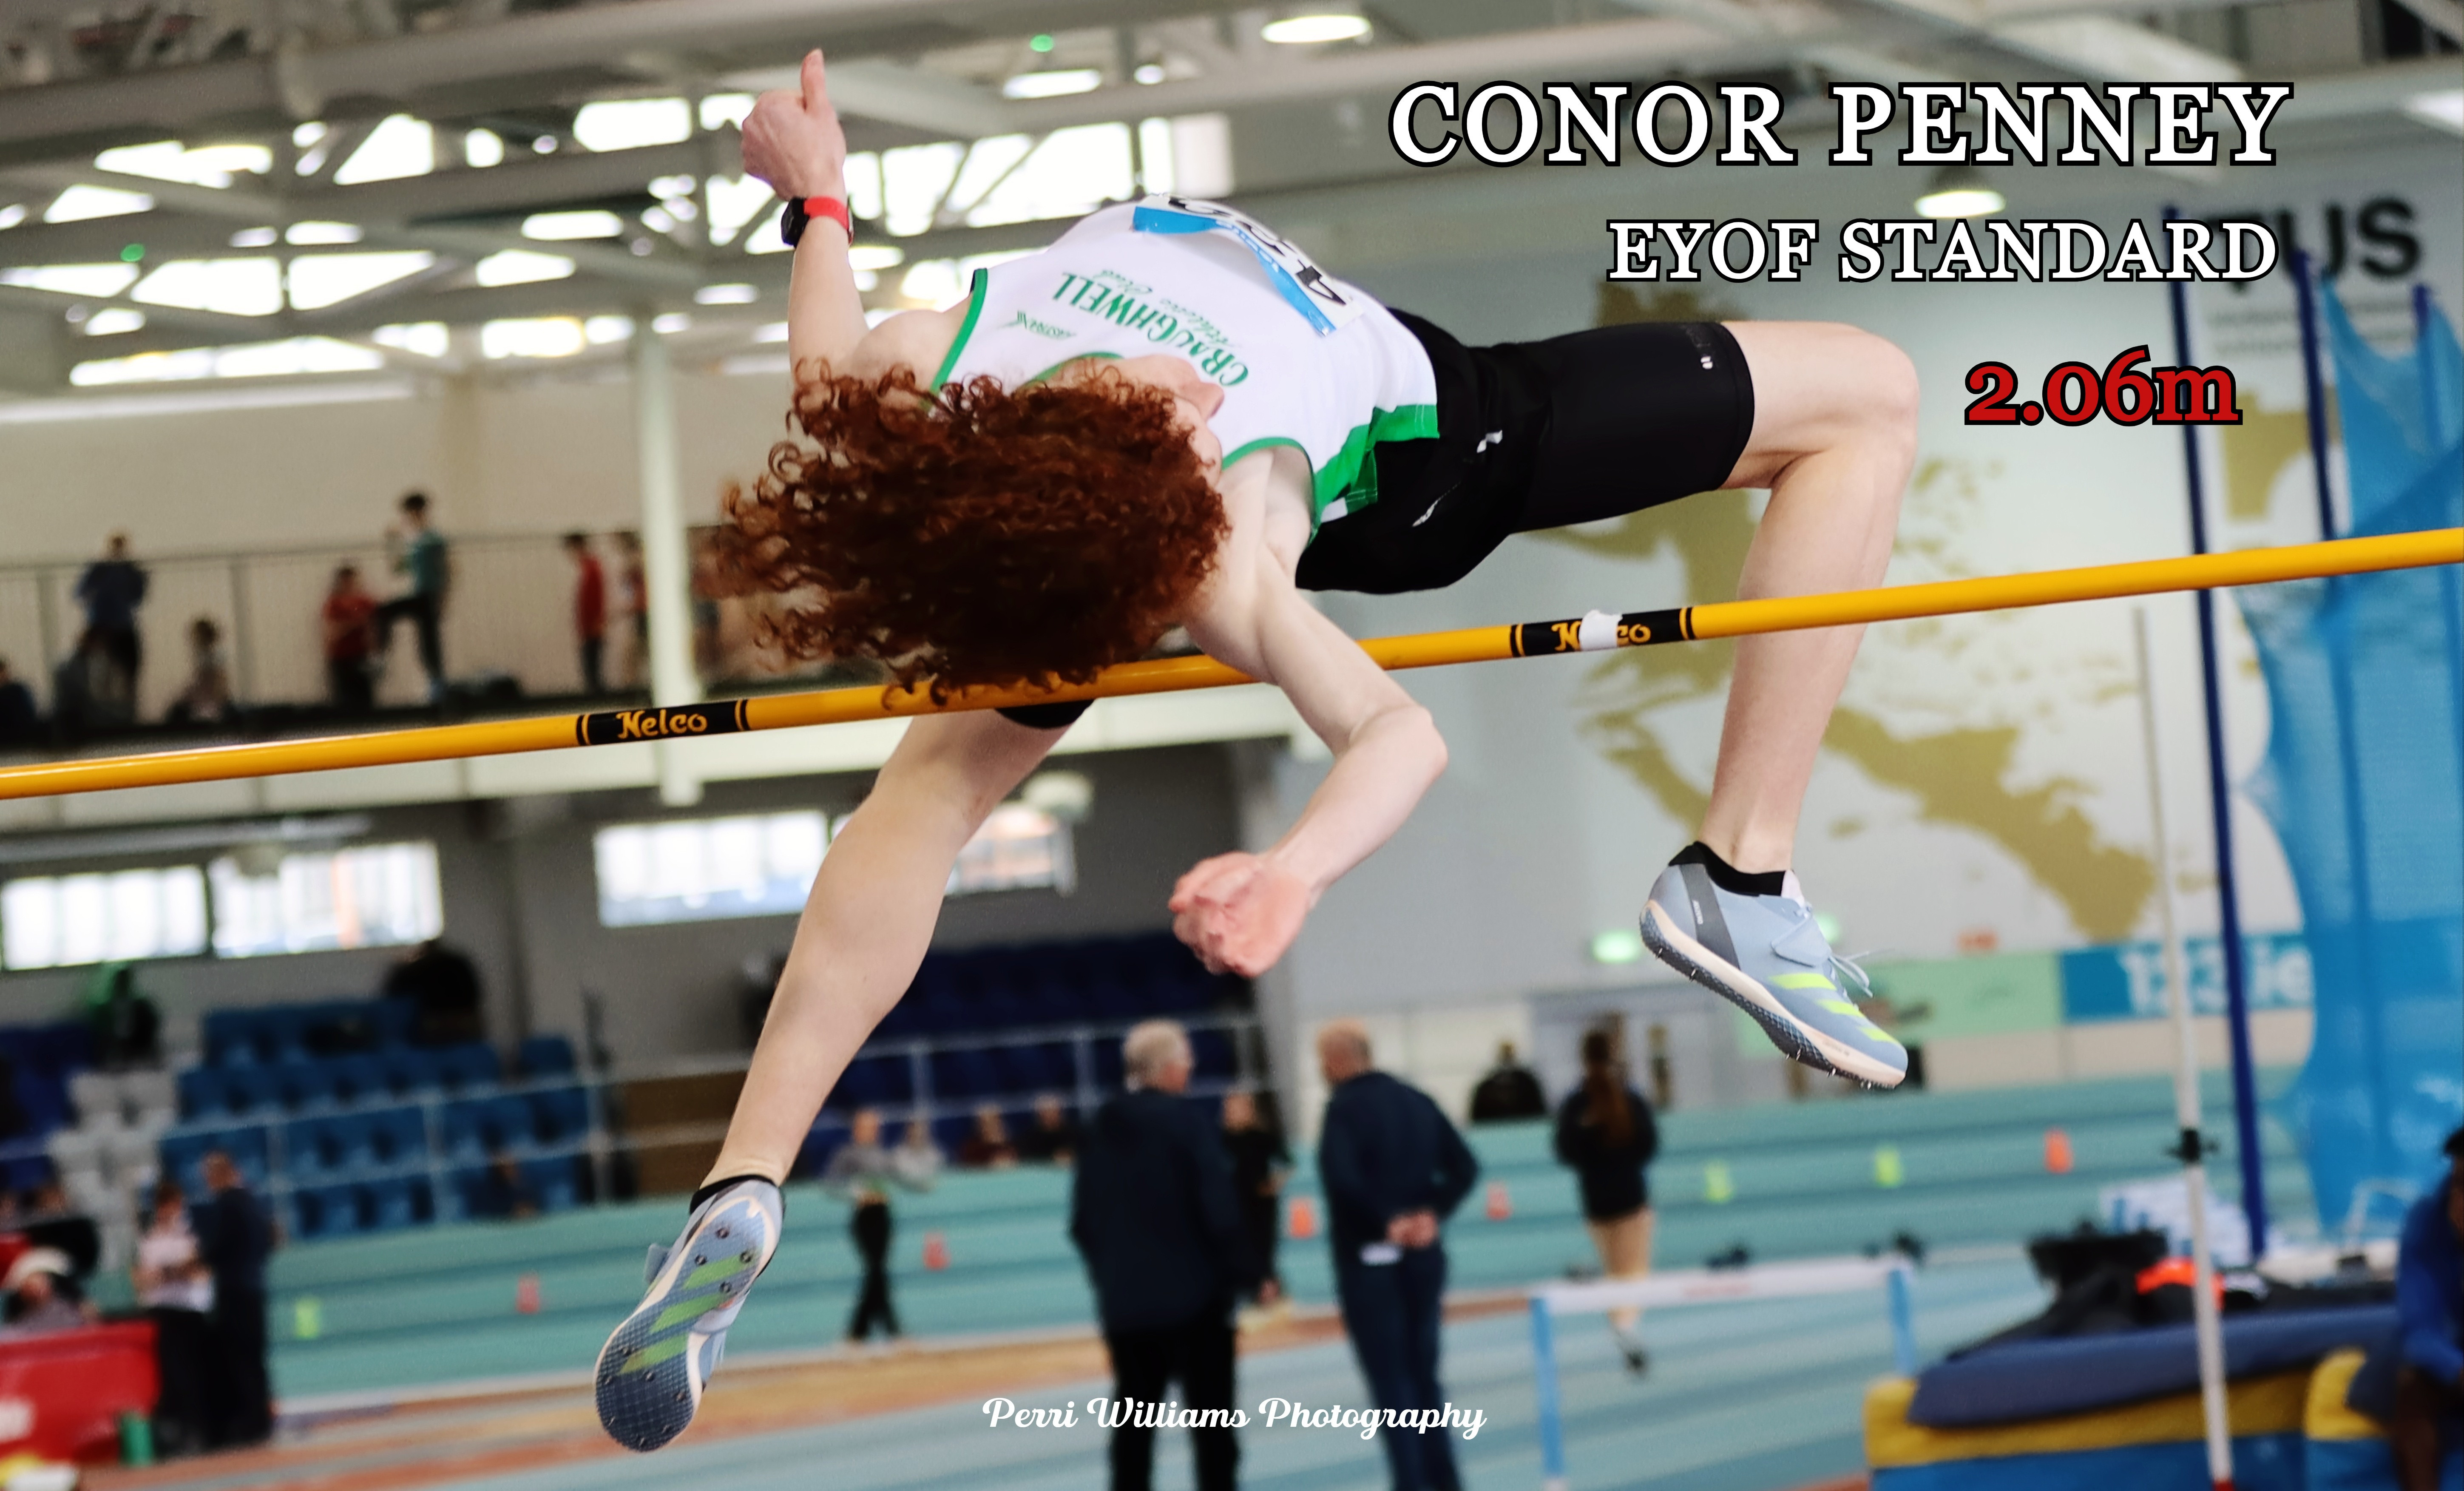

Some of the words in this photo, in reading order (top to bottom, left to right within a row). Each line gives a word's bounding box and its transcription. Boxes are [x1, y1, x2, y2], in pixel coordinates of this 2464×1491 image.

[1053, 272, 1249, 386] CRAUGHWELL
[1551, 621, 1651, 651] Nco
[616, 709, 708, 739] Nelco
